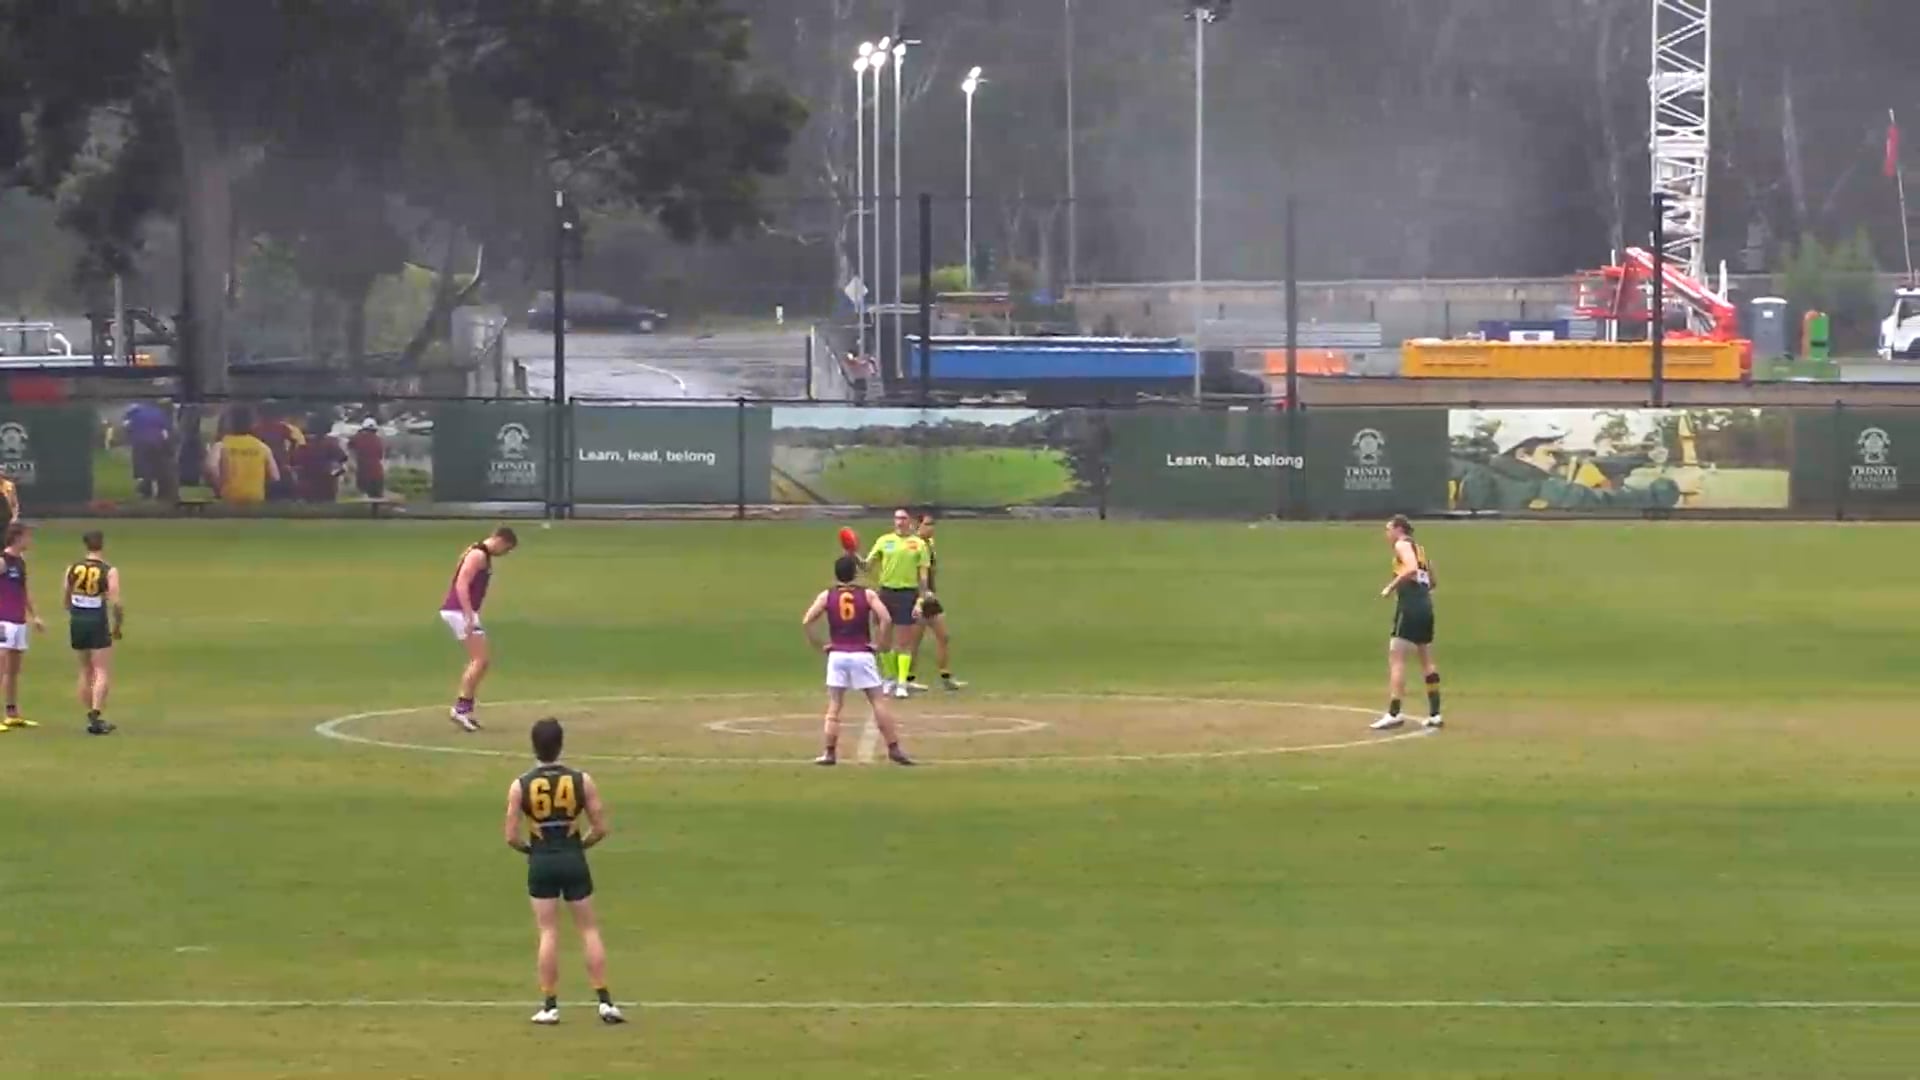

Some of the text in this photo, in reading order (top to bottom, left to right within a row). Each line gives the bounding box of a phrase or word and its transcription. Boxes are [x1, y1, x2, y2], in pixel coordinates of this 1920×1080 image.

[627, 449, 663, 464] lead,
[666, 450, 716, 466] belong
[1166, 454, 1304, 469] Learn, lead, belong
[72, 564, 101, 596] 28
[838, 591, 856, 621] 6
[529, 775, 577, 819] 64
